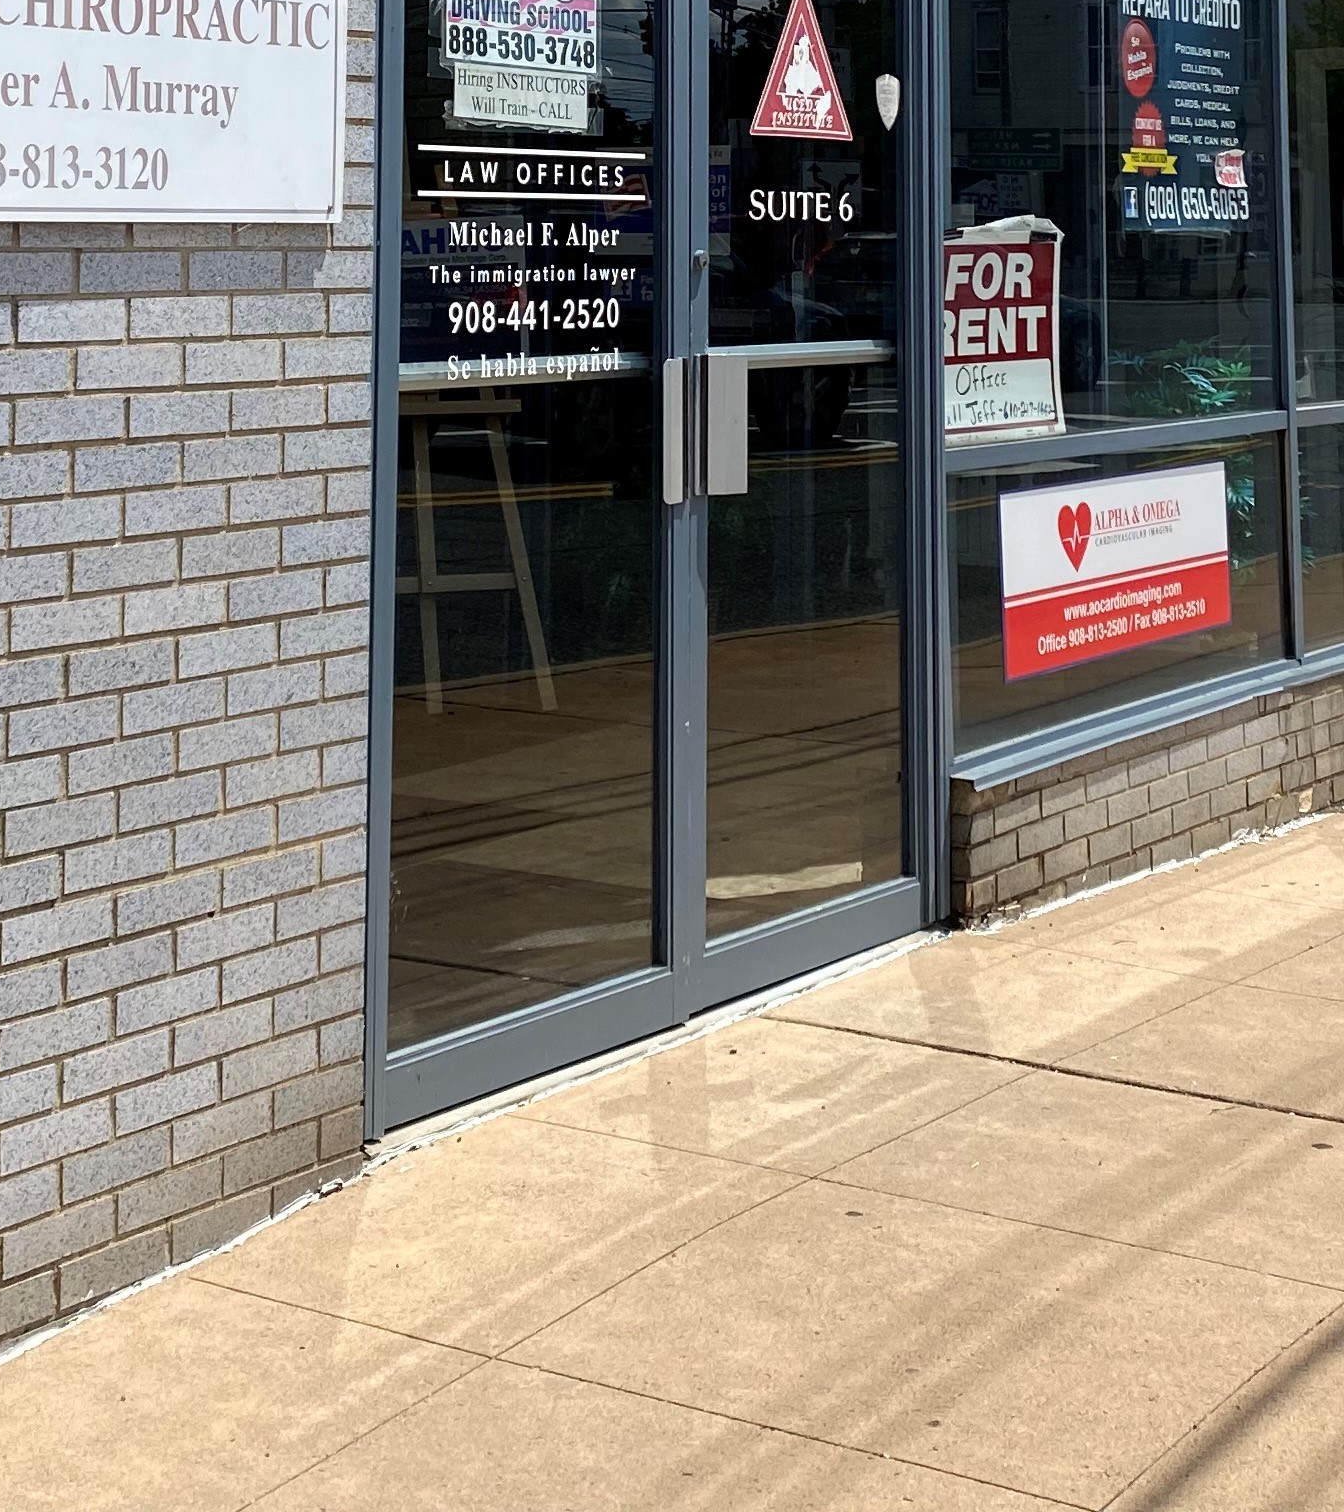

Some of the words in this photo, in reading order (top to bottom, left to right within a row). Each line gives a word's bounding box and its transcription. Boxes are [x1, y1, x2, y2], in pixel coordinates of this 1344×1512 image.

[526, 4, 591, 34] SCHOOL
[448, 25, 595, 69] 888-530-3748
[1175, 43, 1212, 57] PROBLEMS
[1213, 49, 1230, 60] WITH
[48, 60, 91, 111] A.
[102, 64, 240, 129] Murray
[457, 68, 494, 91] Hiring
[497, 72, 586, 96] INSTRUCTORS
[1212, 84, 1240, 95] CREDIT
[471, 96, 496, 114] Will
[499, 99, 528, 117] Train
[538, 102, 572, 120] CALL
[772, 111, 833, 128] INSTITUTE
[1170, 115, 1193, 127] BILLS,
[1221, 120, 1236, 130] AND
[1193, 135, 1203, 144] WE
[1204, 135, 1219, 145] CAN
[1221, 137, 1238, 147] HELP
[444, 160, 499, 184] LAW
[516, 162, 624, 187] OFFICES
[748, 189, 832, 222] SUITE
[839, 192, 853, 222] 6
[1145, 181, 1182, 226] (908)
[1182, 187, 1249, 220] 850-6063
[448, 221, 533, 247] Michael
[540, 222, 559, 246] F.
[565, 223, 620, 252] Alper
[429, 265, 461, 283] The
[470, 264, 576, 287] immigration
[583, 263, 636, 285] lawyer
[944, 252, 1034, 301] FOR
[448, 298, 620, 334] 908-441-2520
[944, 305, 1047, 357] RENT
[447, 355, 471, 381] Se
[480, 352, 537, 378] habla
[541, 347, 620, 381] español
[1094, 508, 1130, 531] ALPHA
[1132, 505, 1140, 524] &
[1142, 498, 1181, 522] OMEGA
[1095, 528, 1147, 547] CARDIOVASCULAR
[1149, 524, 1173, 537] IMAGING
[1064, 581, 1182, 622] www.aocardioimaging.com
[1038, 633, 1067, 655] Office
[1068, 617, 1128, 648] 908-813-2500
[1134, 613, 1151, 631] Fax
[1151, 598, 1206, 626] 908-813-2510
